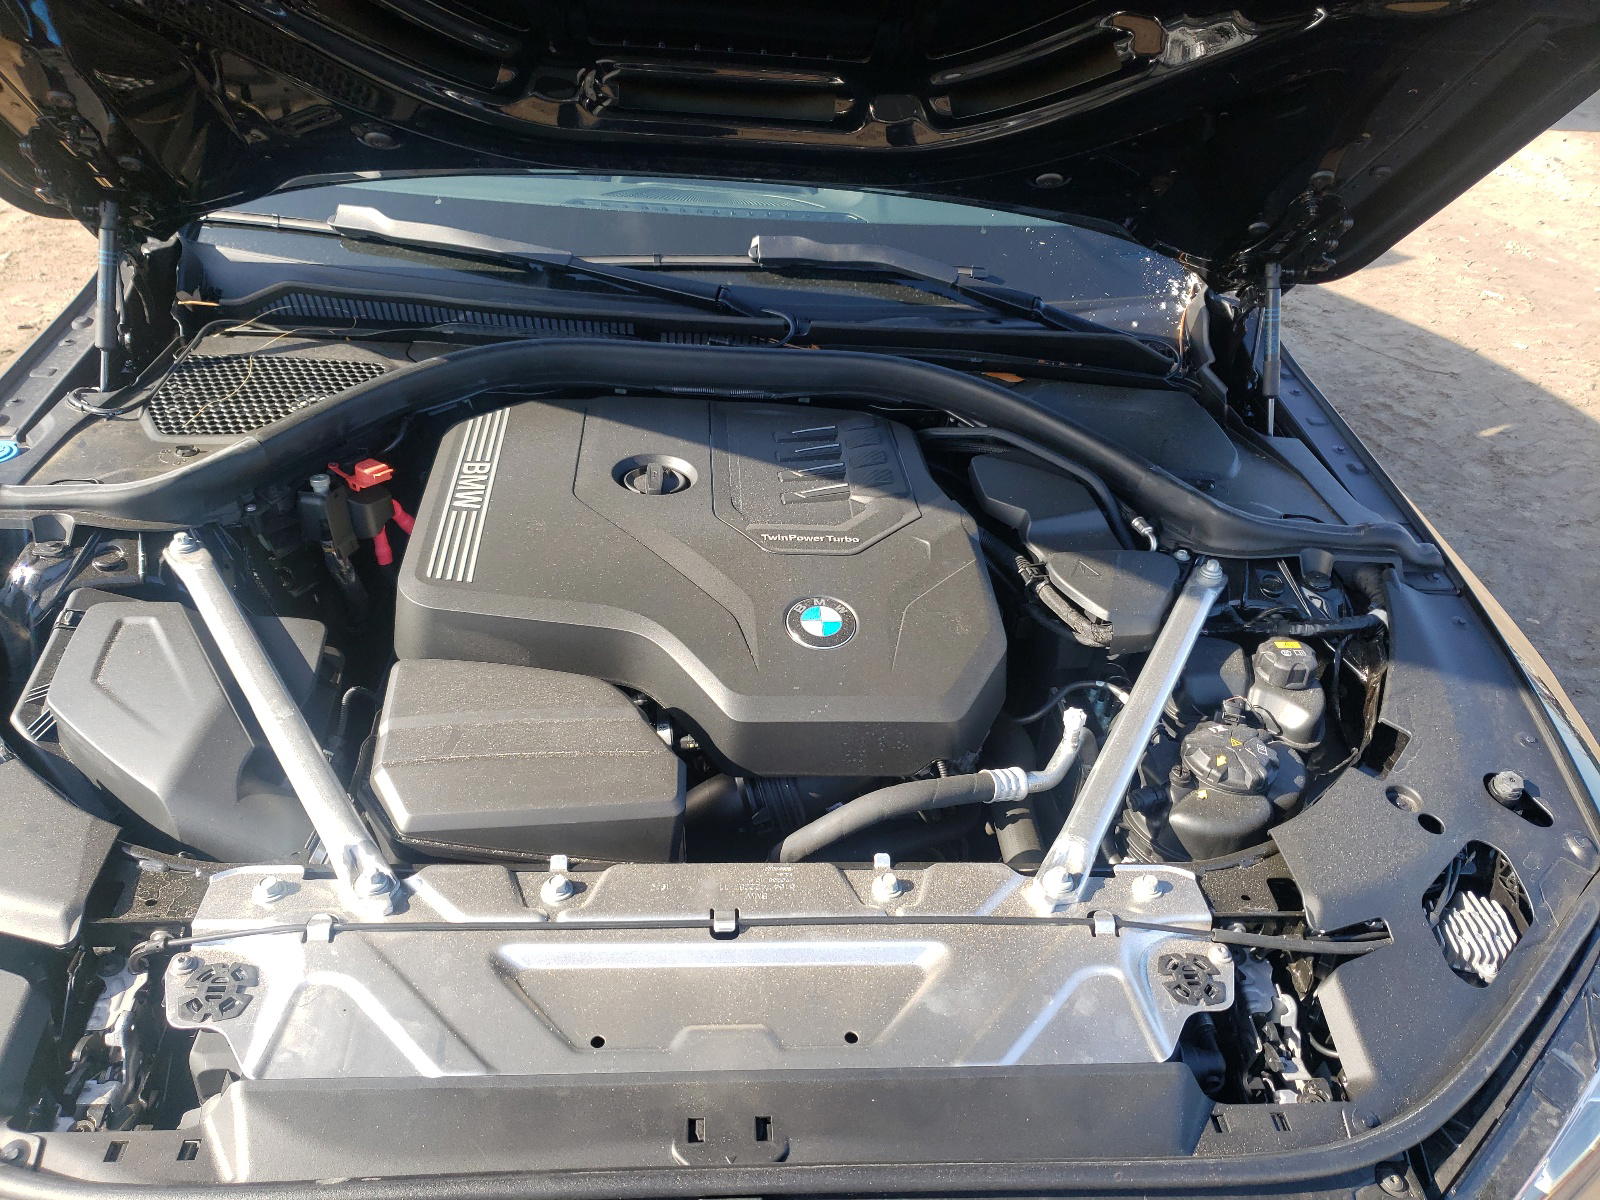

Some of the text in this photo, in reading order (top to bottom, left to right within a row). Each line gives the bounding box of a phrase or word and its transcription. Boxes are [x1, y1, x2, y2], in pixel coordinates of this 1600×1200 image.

[452, 462, 491, 509] BMW
[760, 533, 860, 543] TwinPower Turbo
[794, 598, 848, 614] BMW
